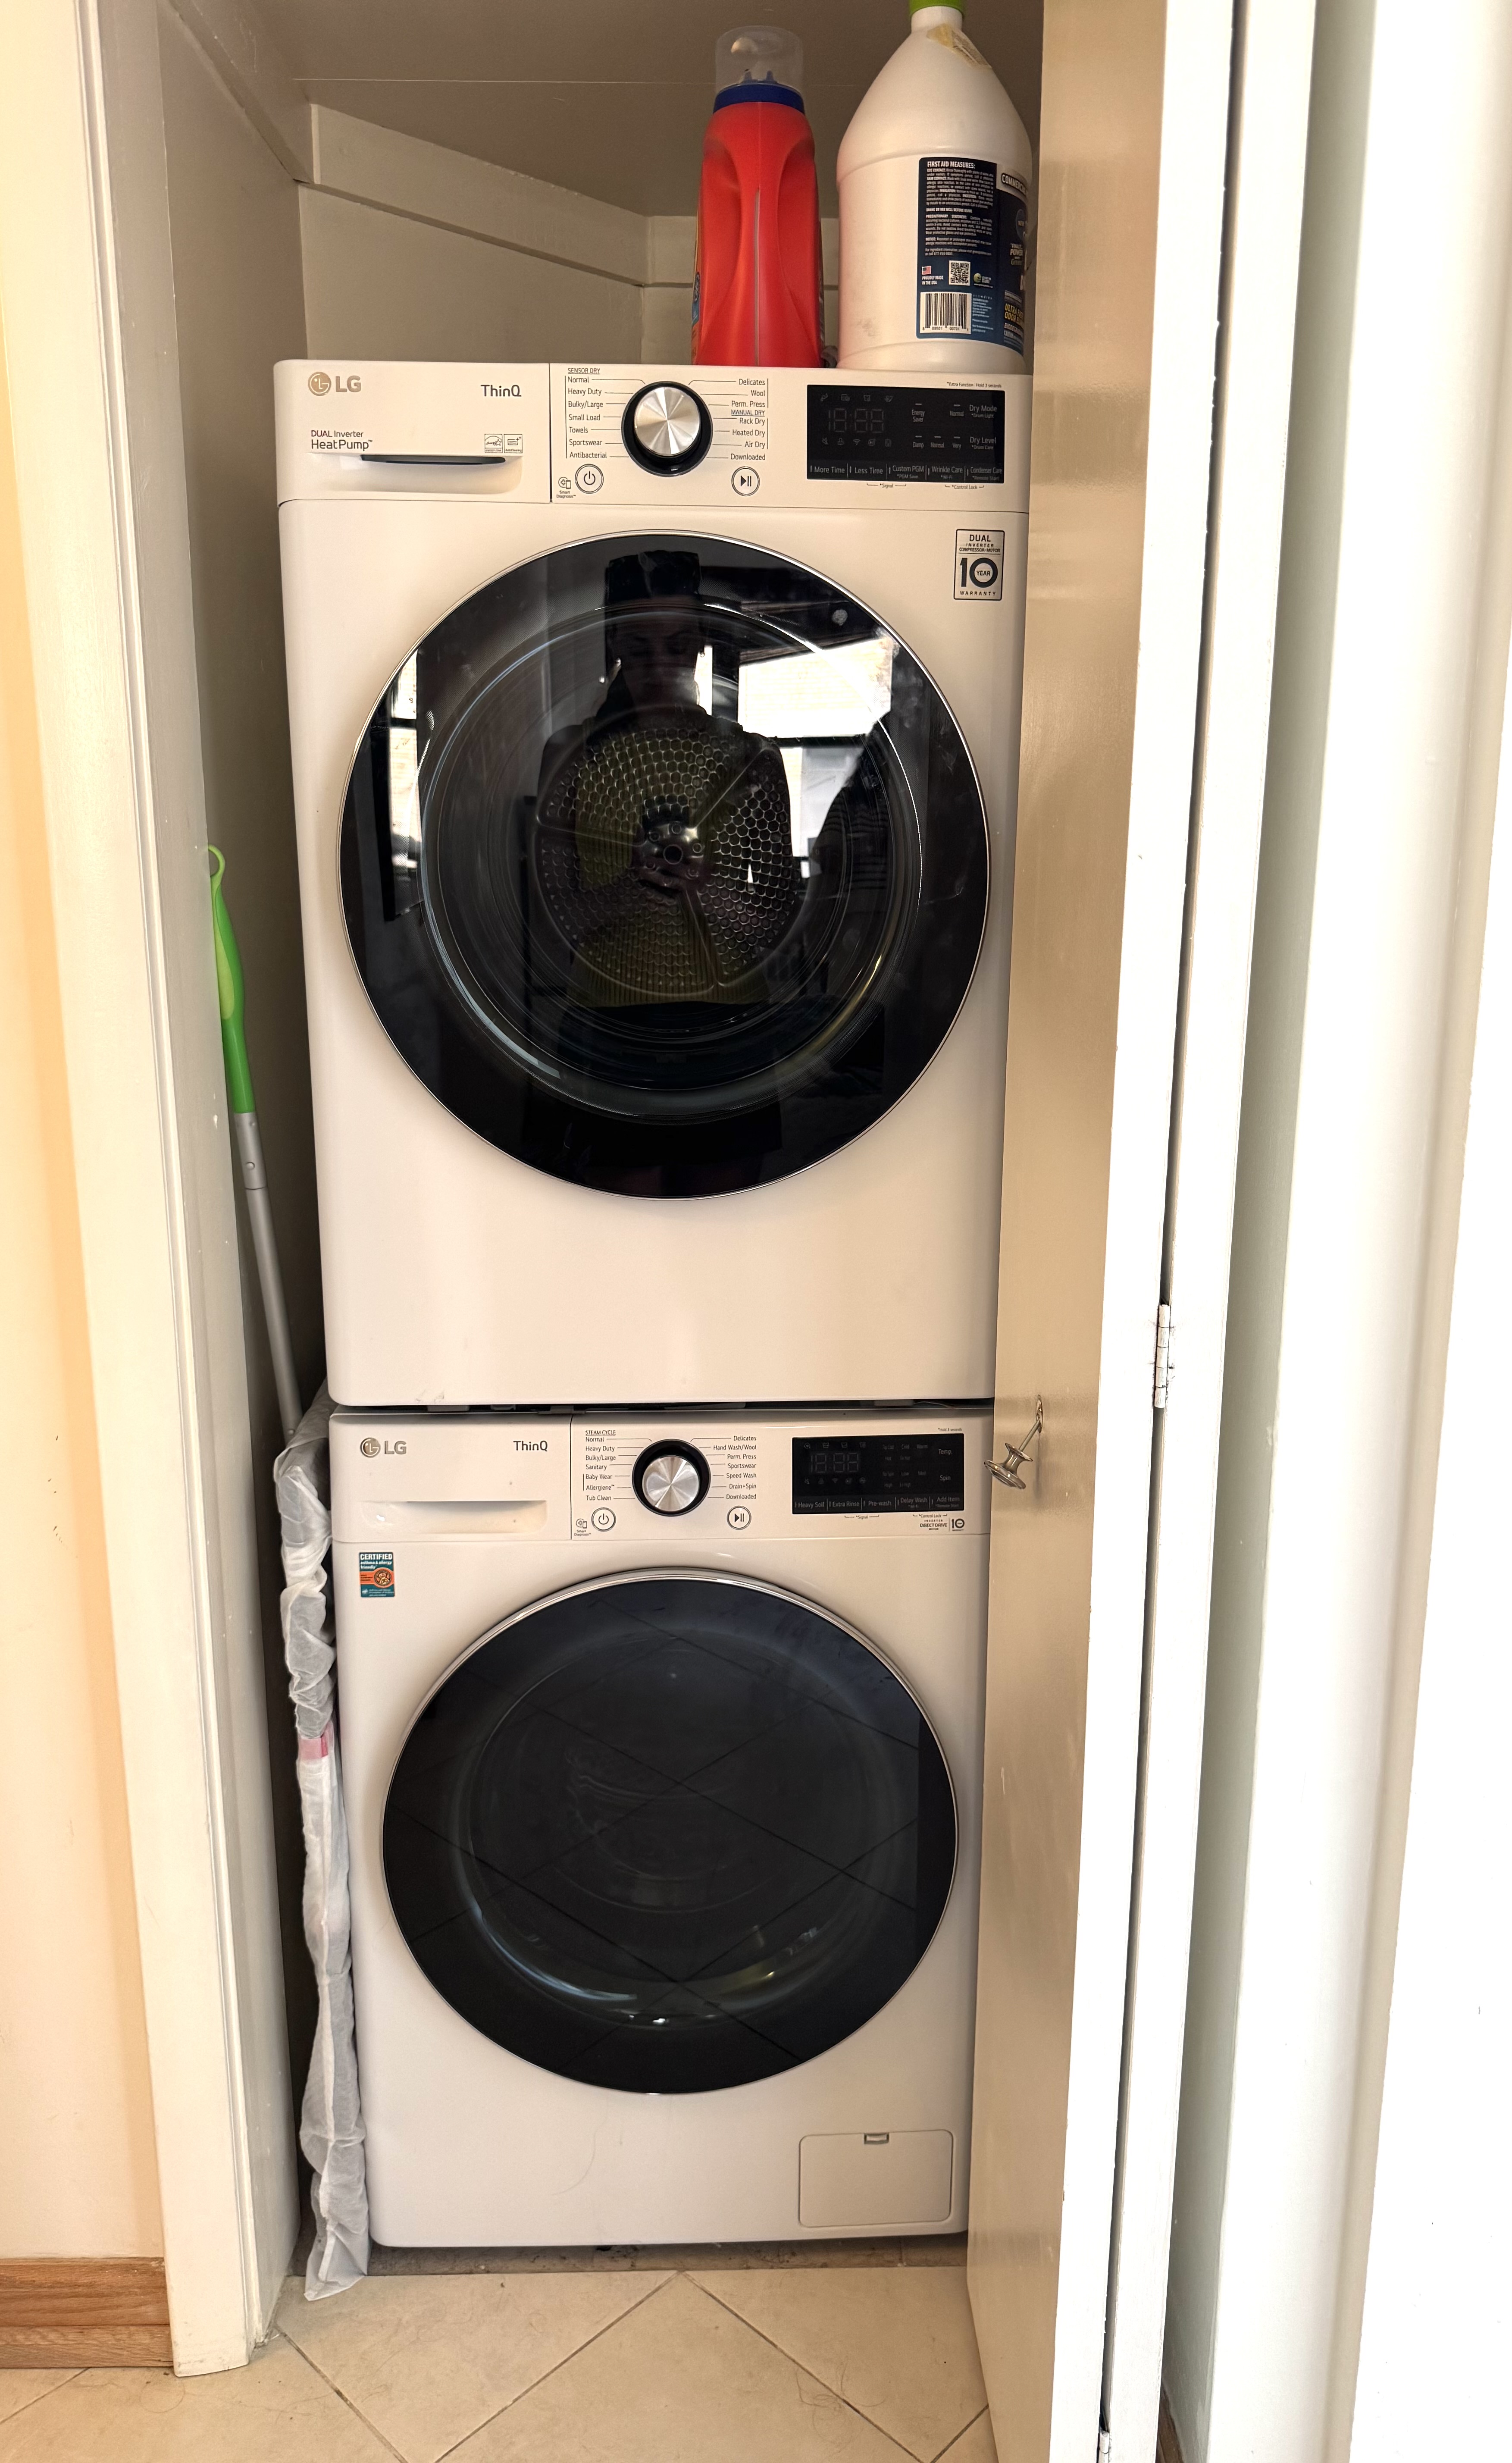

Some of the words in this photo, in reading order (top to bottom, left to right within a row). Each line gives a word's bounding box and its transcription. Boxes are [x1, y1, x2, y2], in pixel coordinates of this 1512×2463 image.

[335, 376, 361, 393] LG
[481, 384, 522, 398] ThinQ
[568, 388, 586, 396] Heavy
[568, 400, 604, 409] Bulky/Large
[969, 404, 980, 413] Dry
[755, 418, 765, 426] Dry
[311, 429, 333, 438] DUAL
[755, 429, 765, 438] Dry
[755, 441, 765, 449] Dry
[970, 437, 980, 445] Dry
[960, 558, 998, 588] 10
[385, 1440, 407, 1454] LG
[513, 1440, 548, 1452] ThinQ
